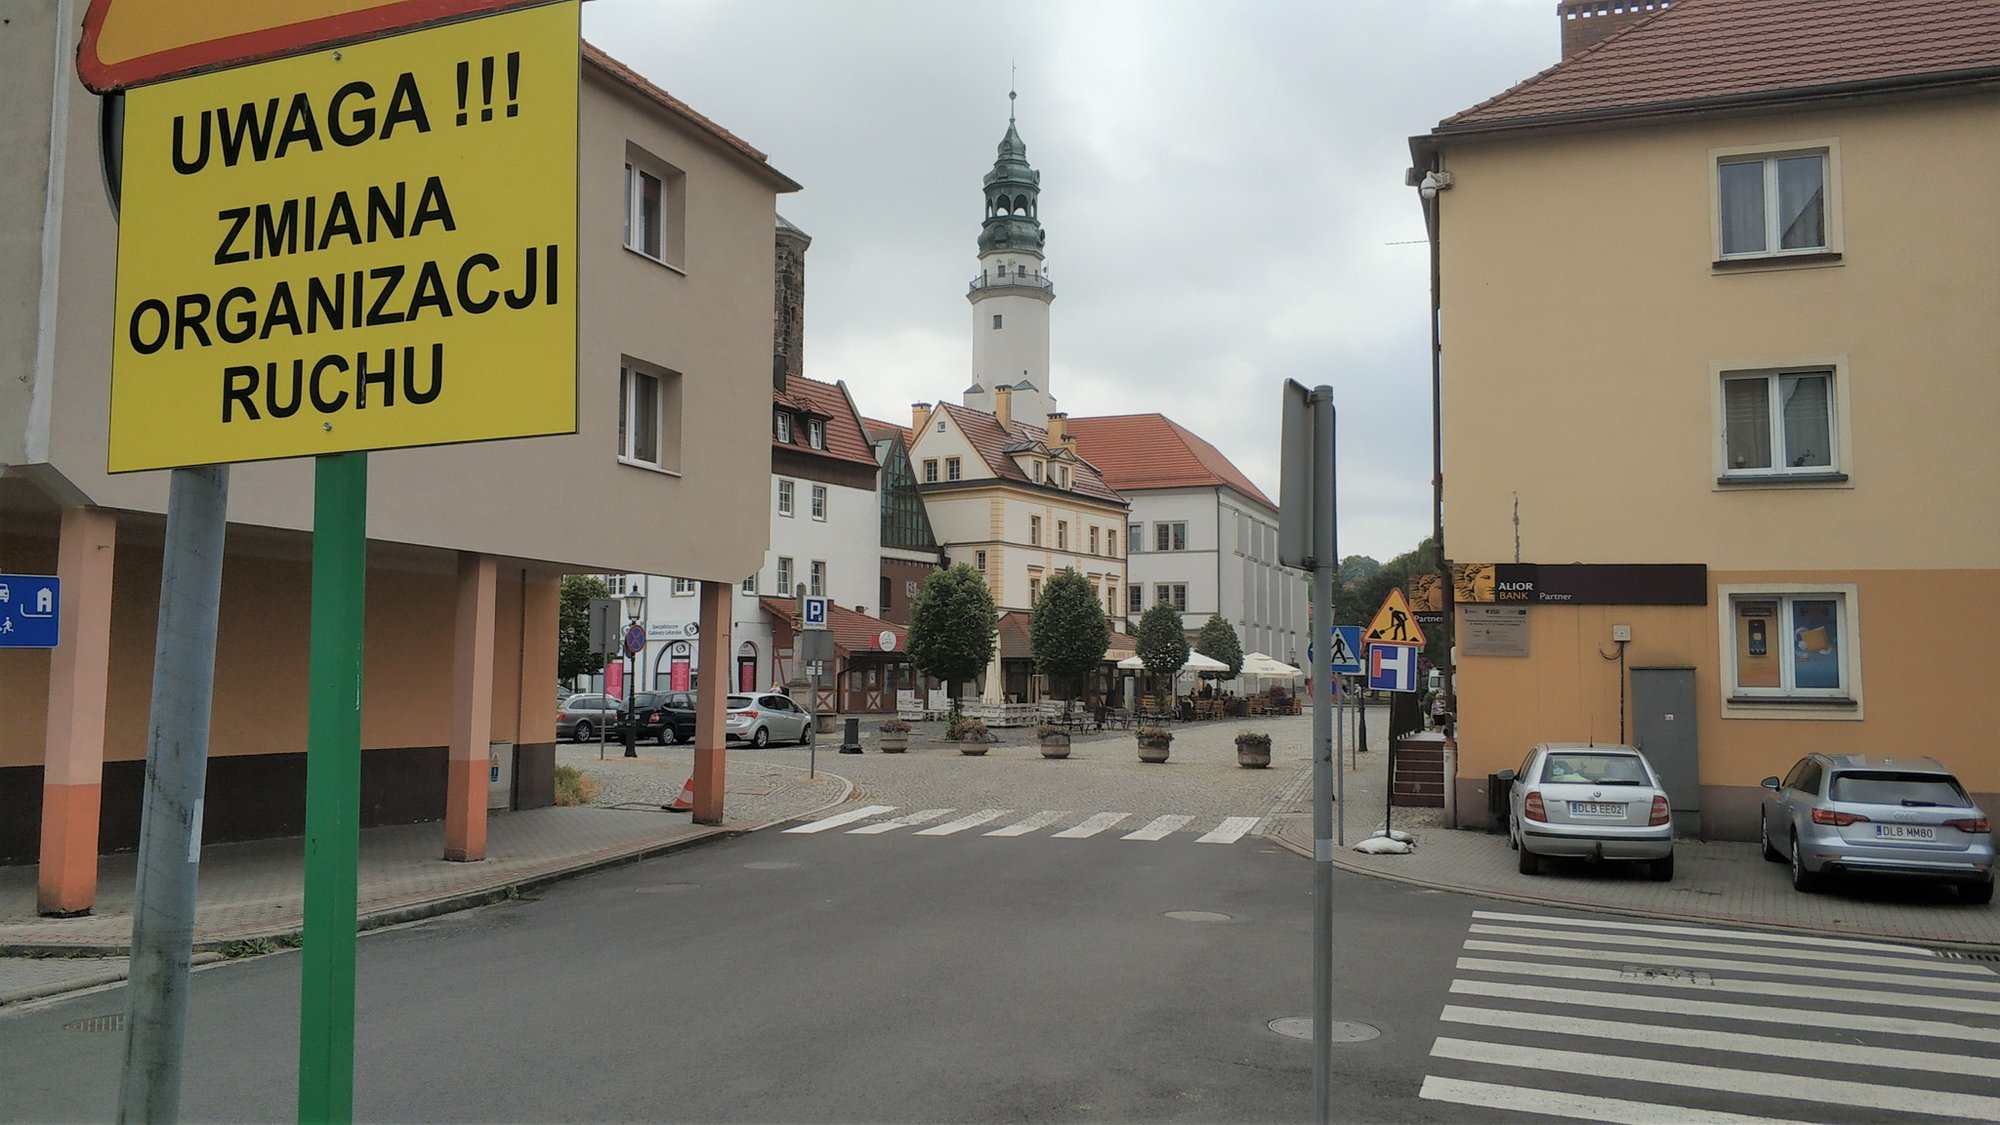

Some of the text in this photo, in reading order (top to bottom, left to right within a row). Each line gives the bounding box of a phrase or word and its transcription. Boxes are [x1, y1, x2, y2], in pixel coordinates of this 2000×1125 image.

[173, 52, 519, 174] UWAGA !!!
[214, 176, 456, 265] ZMIANA
[129, 245, 558, 354] ORGANIZACJI
[223, 344, 442, 423] RUCHU
[1498, 582, 1533, 591] ALIOR
[1499, 592, 1529, 600] BANK
[1539, 592, 1573, 601] Partner
[810, 601, 822, 620] P
[1578, 804, 1622, 814] DLB EE02
[1883, 826, 1933, 838] DLB MM80
